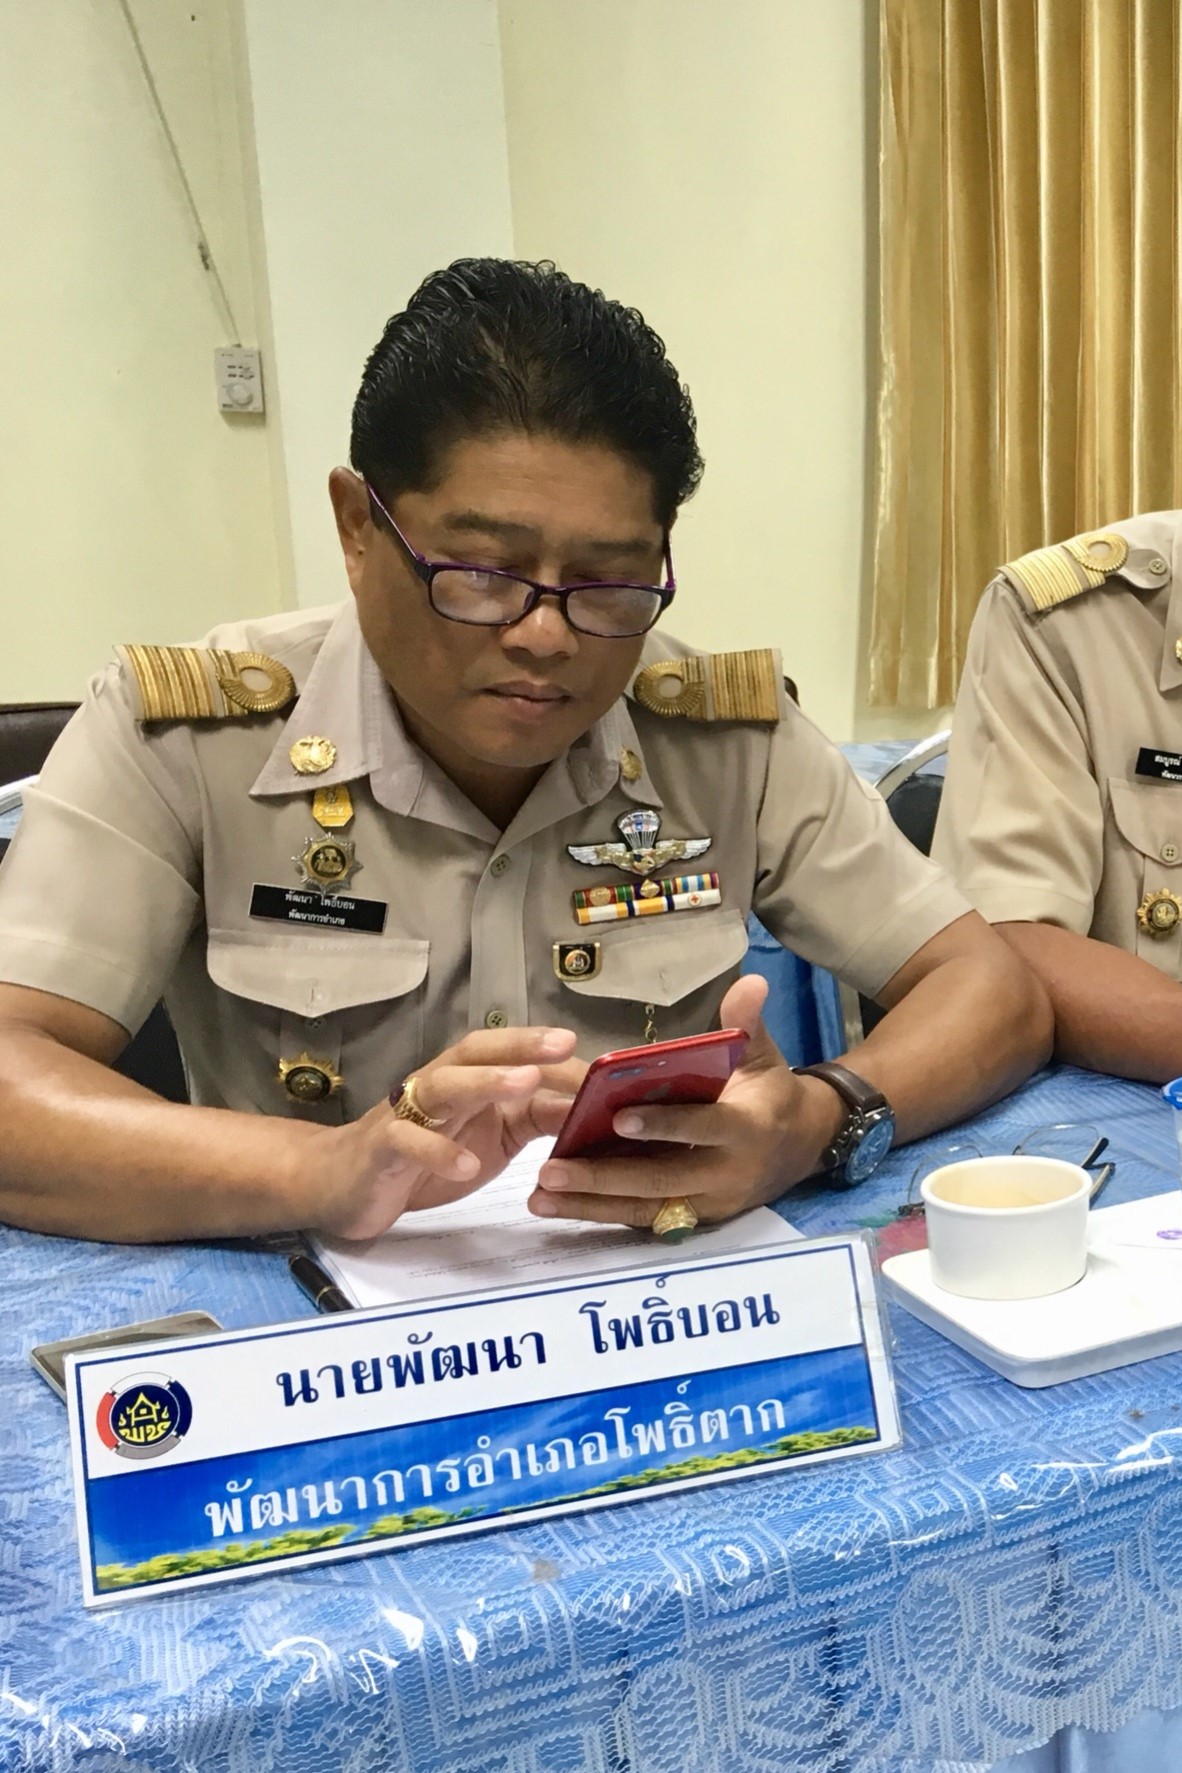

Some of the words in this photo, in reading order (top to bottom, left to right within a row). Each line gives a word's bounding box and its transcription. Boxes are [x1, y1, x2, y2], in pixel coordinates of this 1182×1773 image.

[285, 890, 314, 905] พัฒนา
[275, 1330, 547, 1407] นายพัฒนา
[578, 1273, 781, 1354] โพธิ์บอน
[203, 1379, 788, 1538] พัฒนาการอำเภอโพธิ์ตาก
